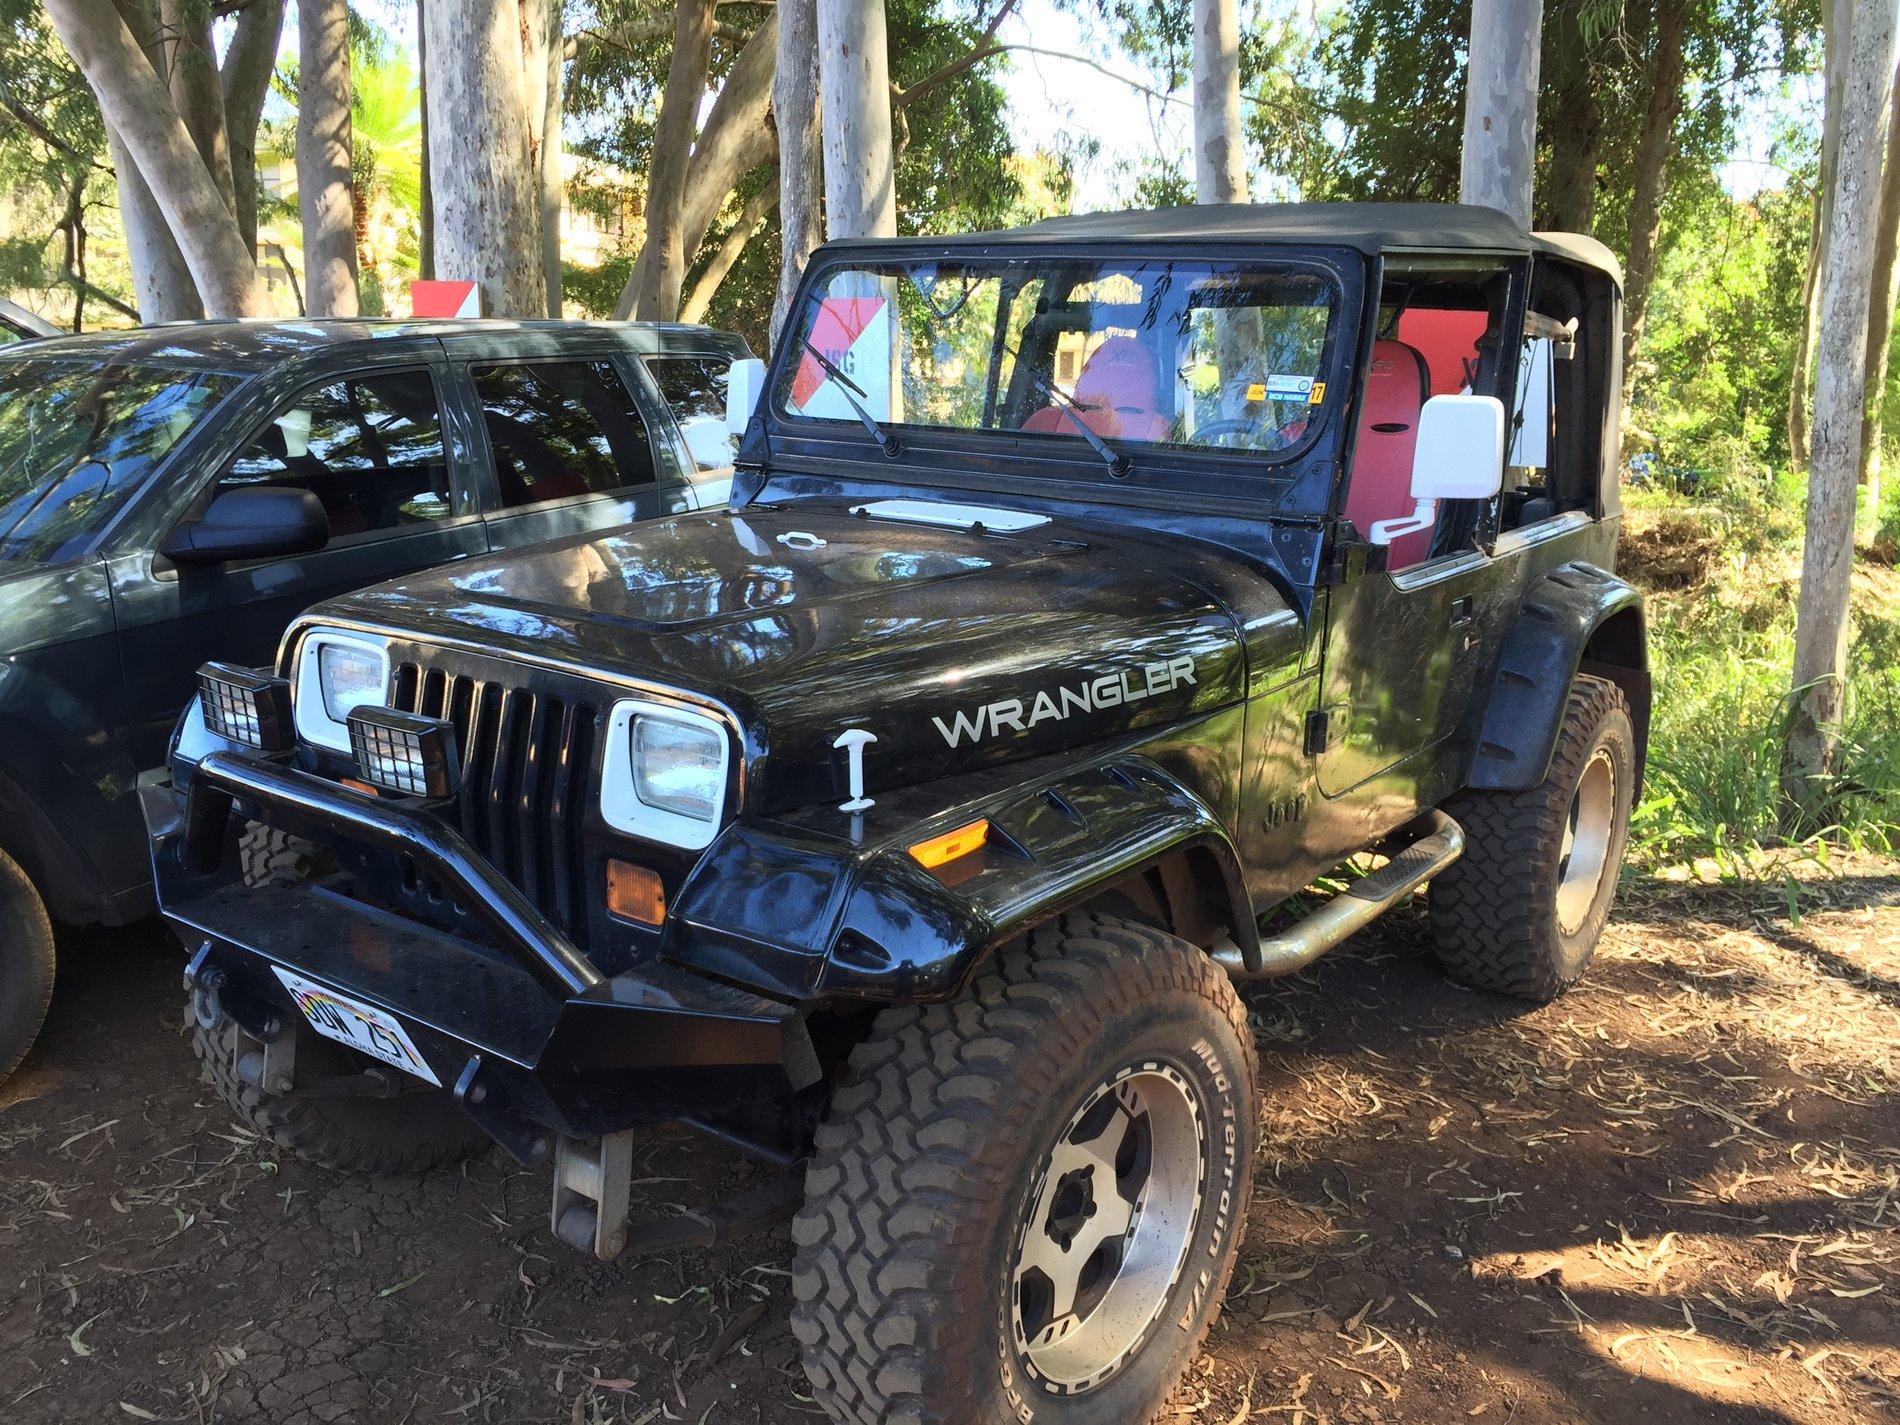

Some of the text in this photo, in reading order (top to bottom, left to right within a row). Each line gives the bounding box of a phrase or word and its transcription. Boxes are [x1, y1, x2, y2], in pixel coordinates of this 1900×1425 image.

[1311, 386, 1323, 400] 17
[932, 656, 1198, 749] WRANGLER
[354, 1015, 419, 1067] 251
[377, 1051, 403, 1067] STATE
[1177, 1038, 1237, 1332] Mud-Terrain T/A
